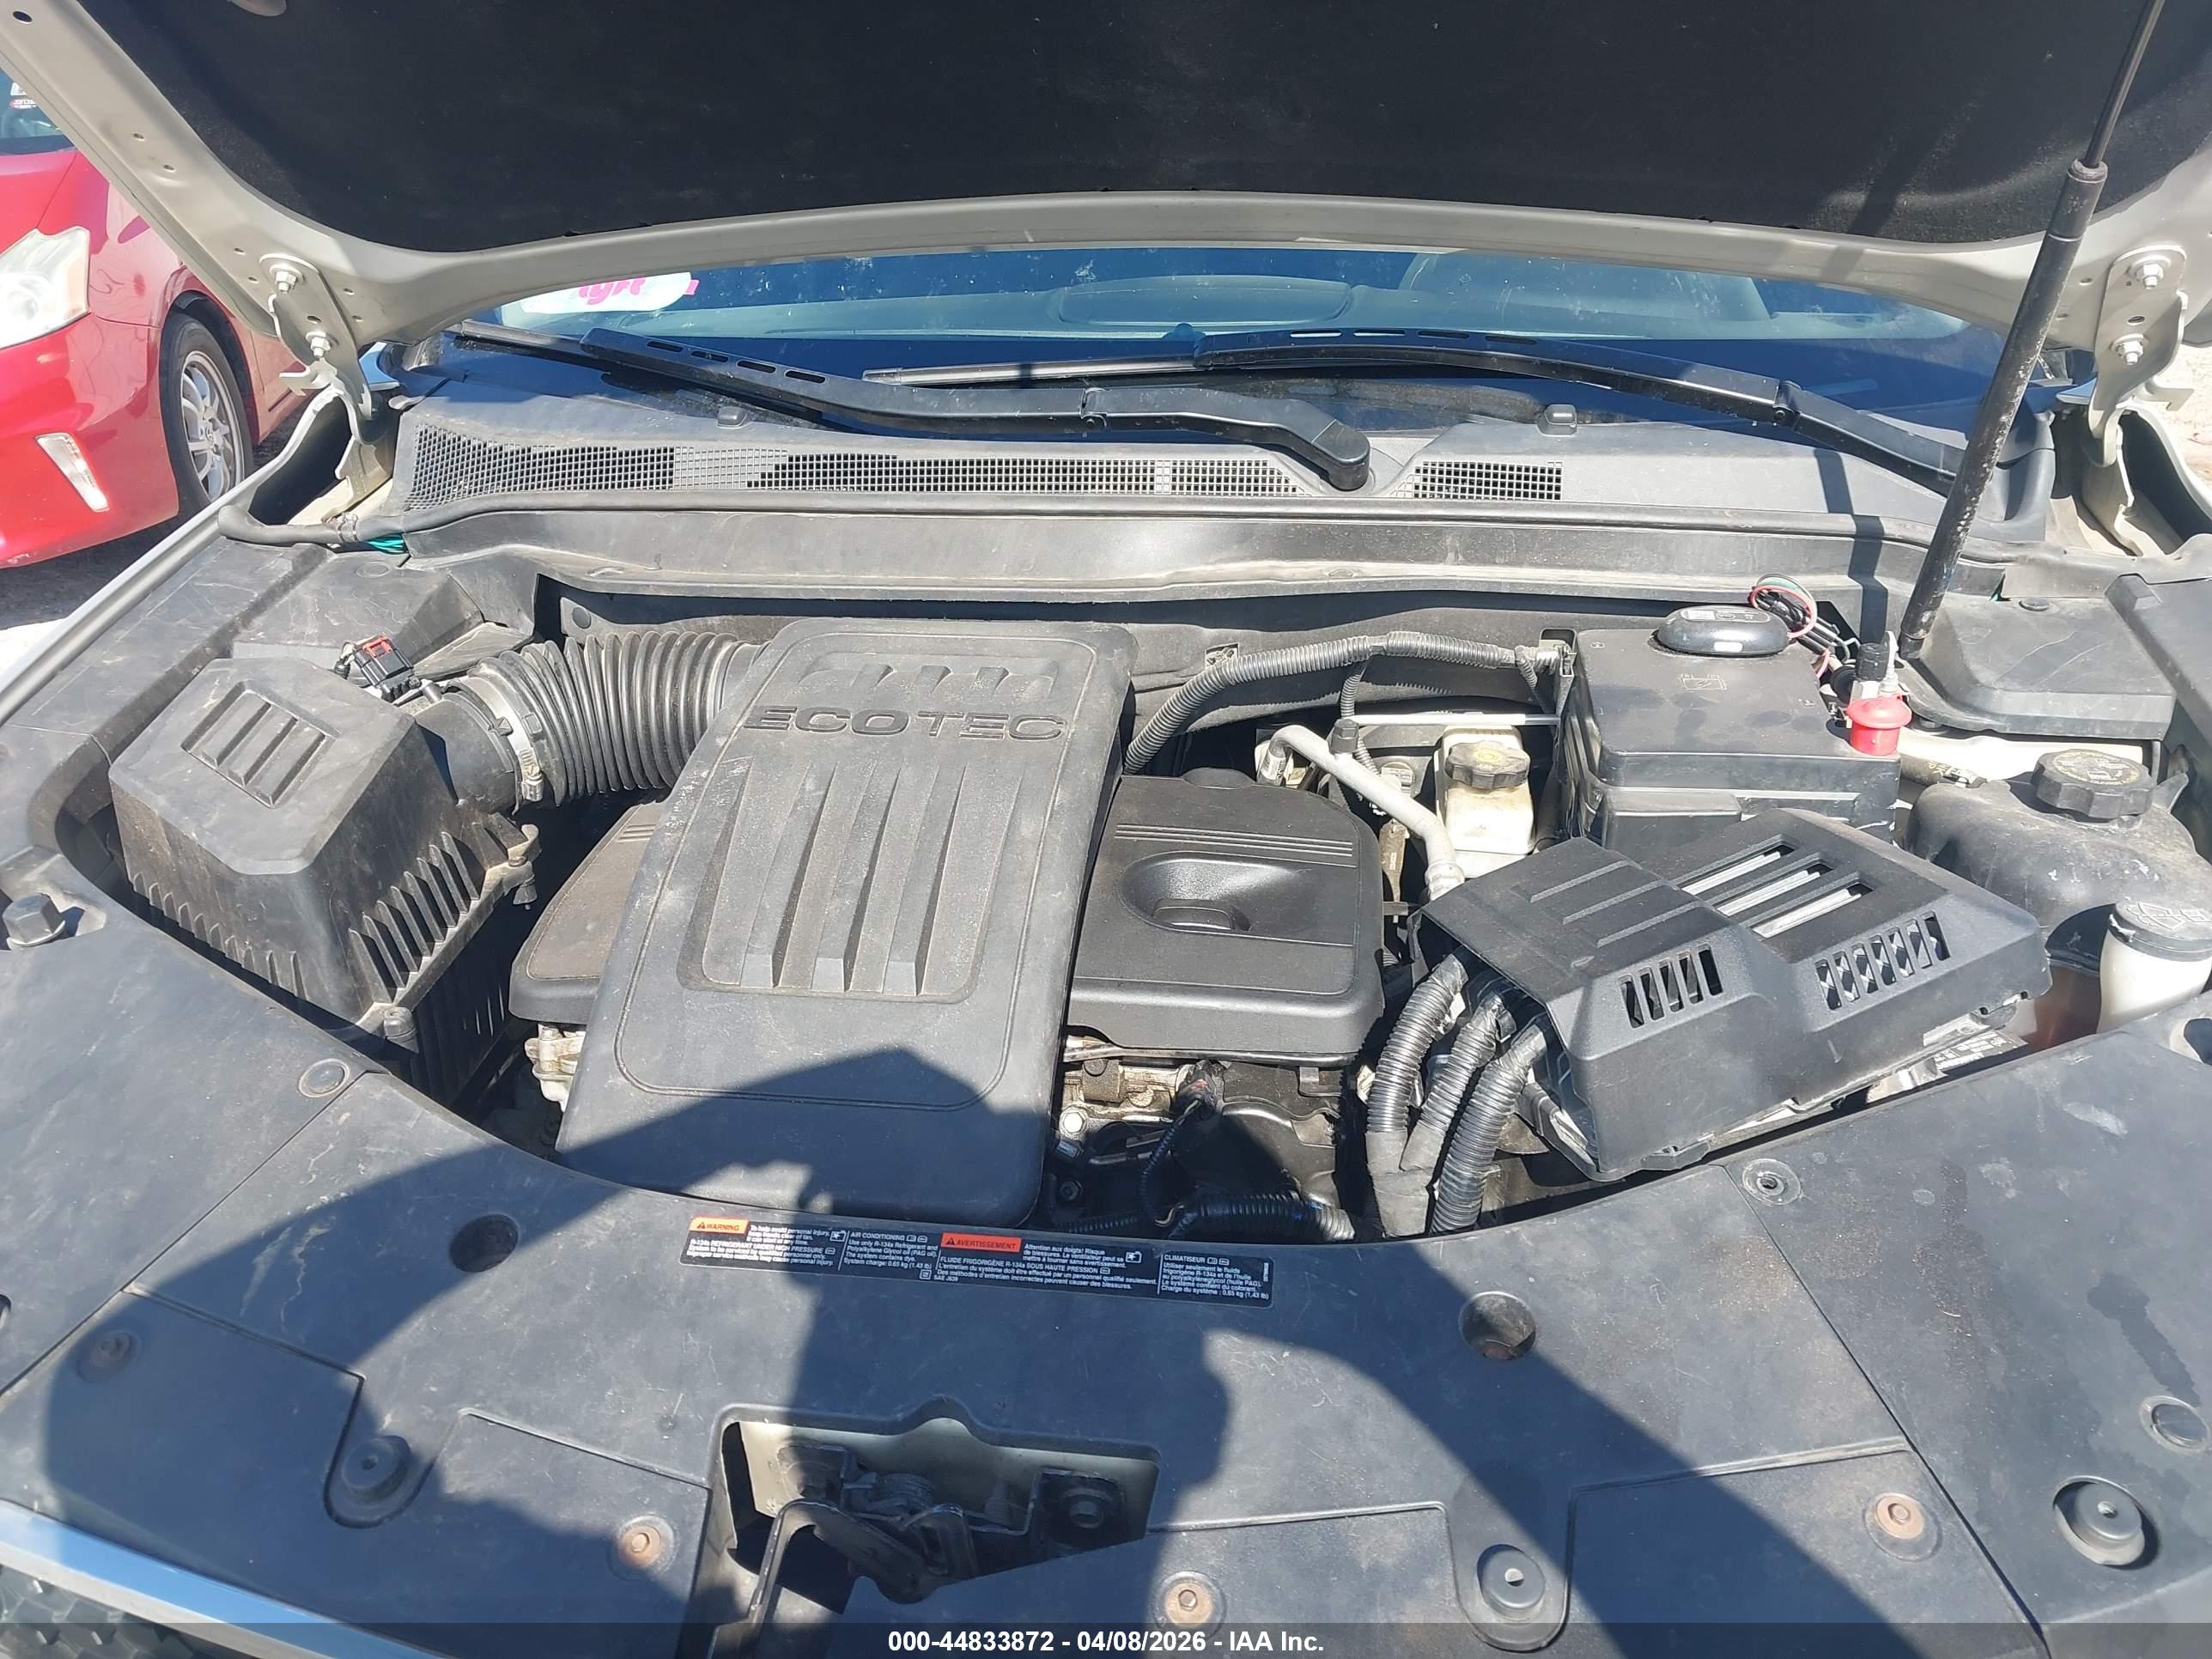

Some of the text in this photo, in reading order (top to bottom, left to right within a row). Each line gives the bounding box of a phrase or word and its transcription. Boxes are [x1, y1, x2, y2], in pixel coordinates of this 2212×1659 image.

[744, 706, 1066, 741] ECOTEC
[957, 1240, 1017, 1249] AVERTISSEMENT
[963, 1258, 1004, 1267] FRIGORIGÈNE
[1164, 1255, 1205, 1263] CLIMATISEUR
[1073, 1273, 1102, 1282] personnel
